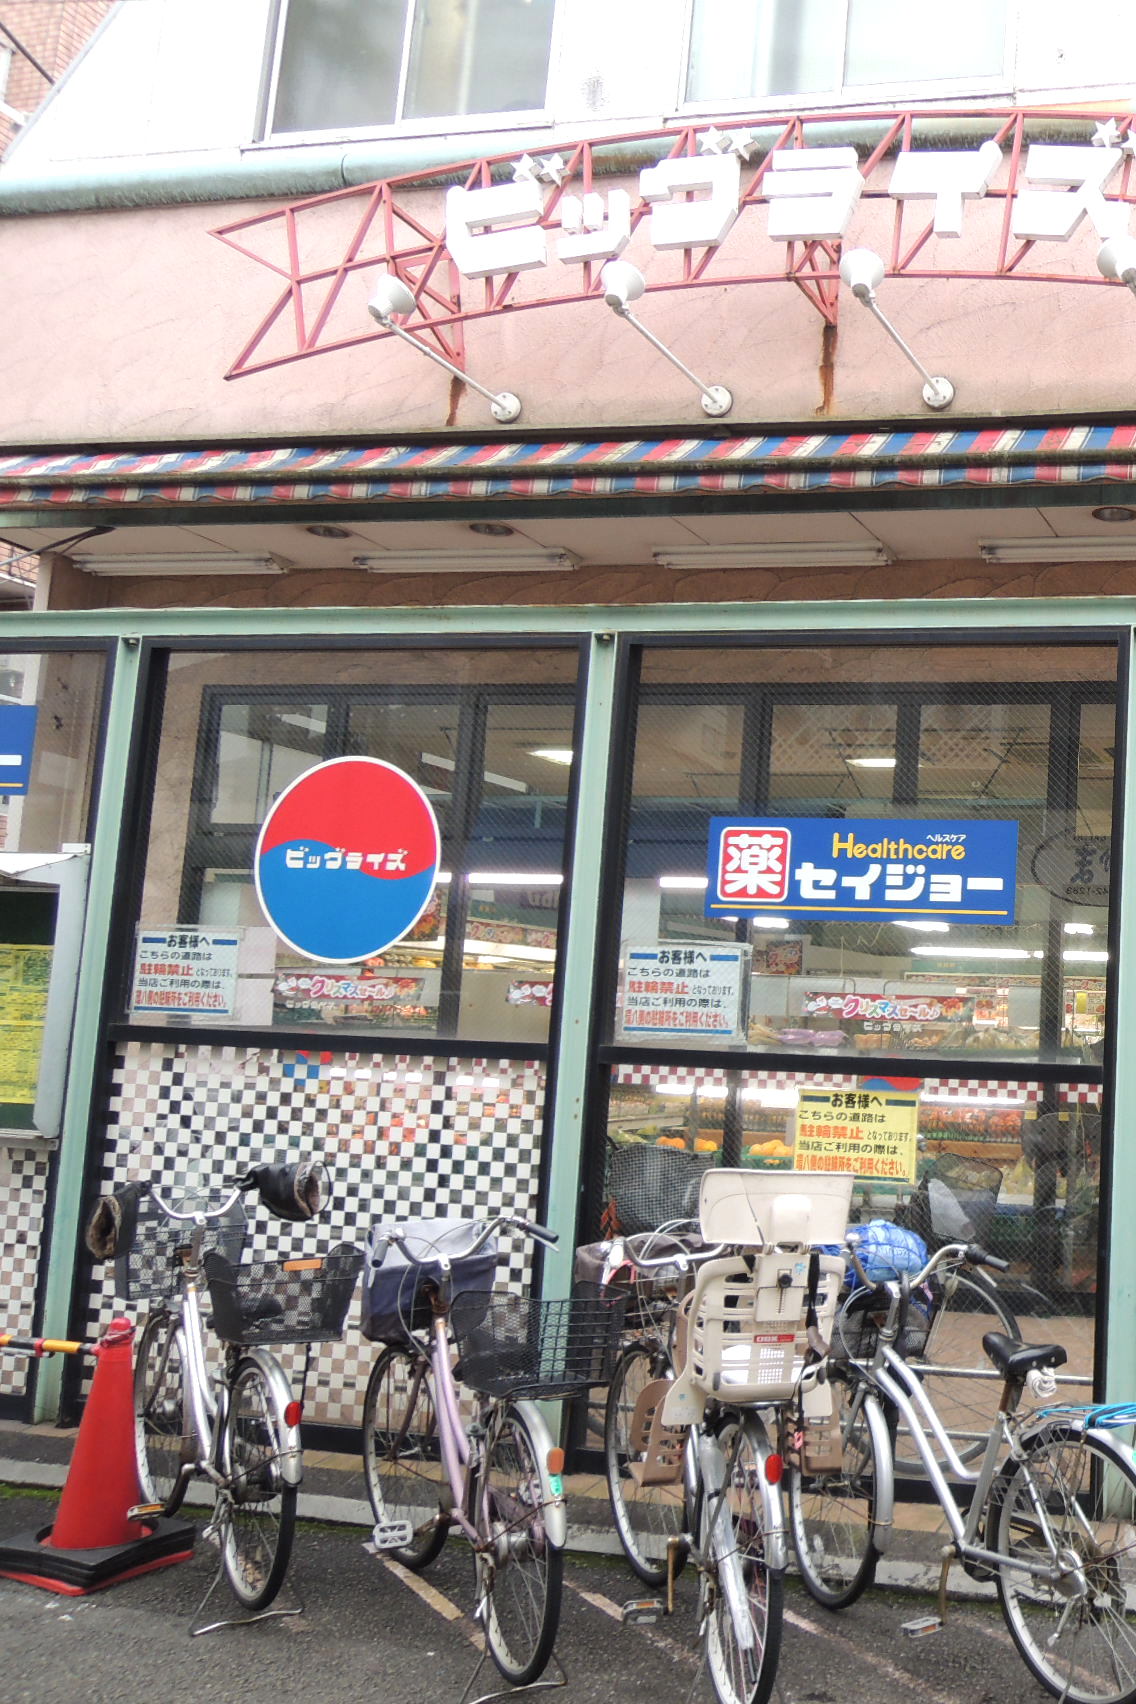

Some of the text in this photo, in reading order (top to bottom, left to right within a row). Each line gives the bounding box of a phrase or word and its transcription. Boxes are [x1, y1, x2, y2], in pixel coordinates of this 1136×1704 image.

[926, 833, 967, 843] ヘルスケア
[832, 832, 967, 860] Healthcare
[286, 846, 408, 871] ビッグライズ
[724, 833, 784, 895] 薬
[795, 862, 1004, 902] セイジョー
[167, 934, 210, 949] お客様へ
[658, 950, 708, 965] お客様へ
[628, 967, 711, 979] こちらの道路は
[629, 980, 689, 995] 駐輪禁止
[831, 1093, 883, 1109] お客様へ
[798, 1110, 887, 1123] こちらの道路は
[800, 1124, 864, 1140] 駐輪禁止
[799, 1140, 903, 1155] 当店ご利用の際は、
